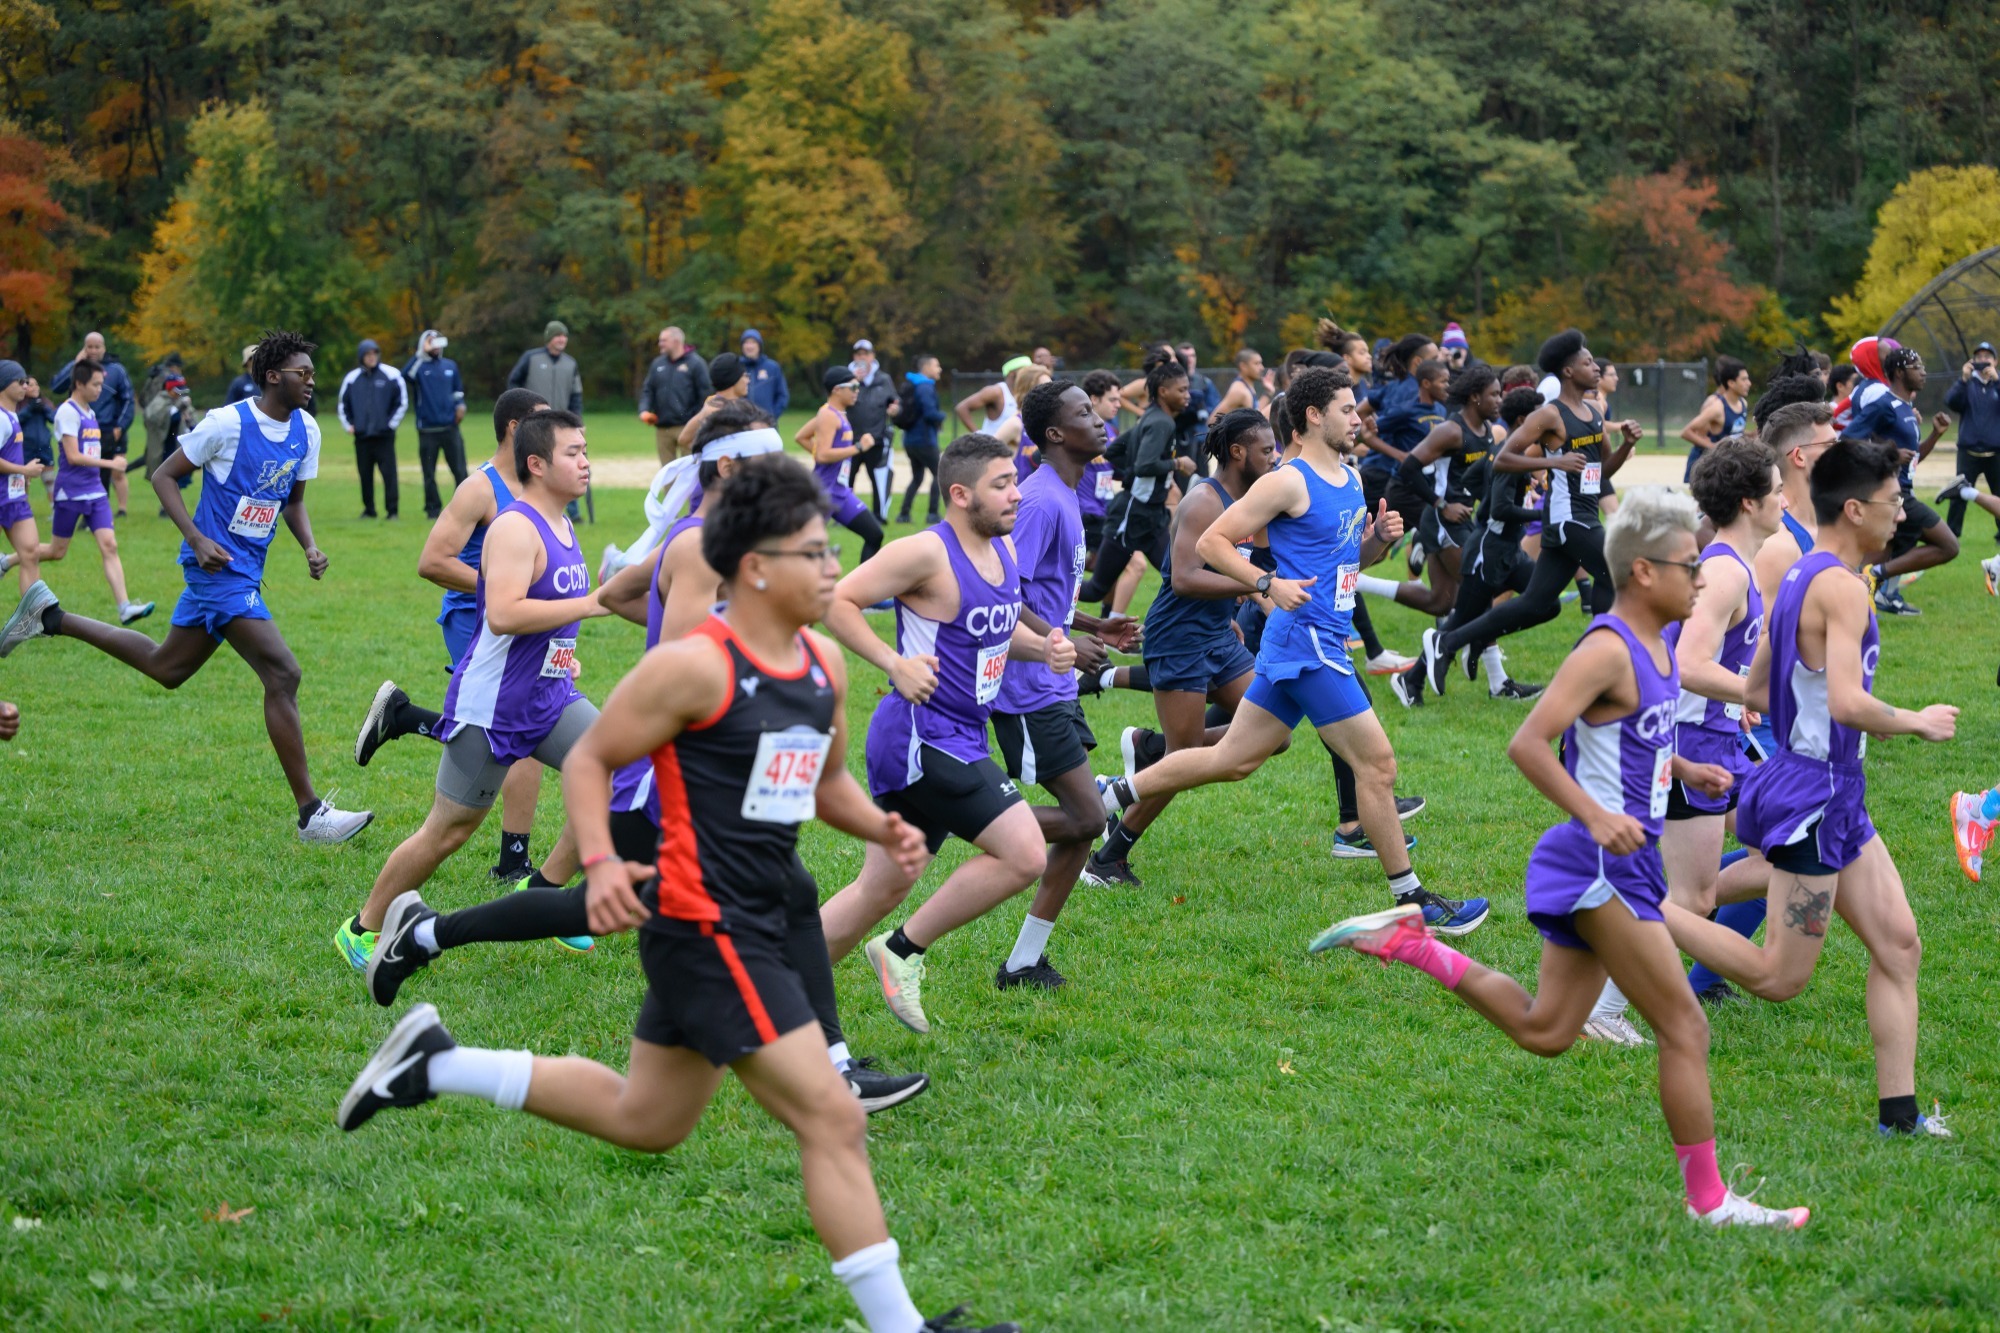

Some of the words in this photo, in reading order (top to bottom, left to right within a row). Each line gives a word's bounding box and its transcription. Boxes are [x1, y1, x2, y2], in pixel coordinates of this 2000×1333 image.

[241, 505, 275, 524] 4750
[553, 563, 590, 594] CCN
[765, 752, 821, 785] 4745
